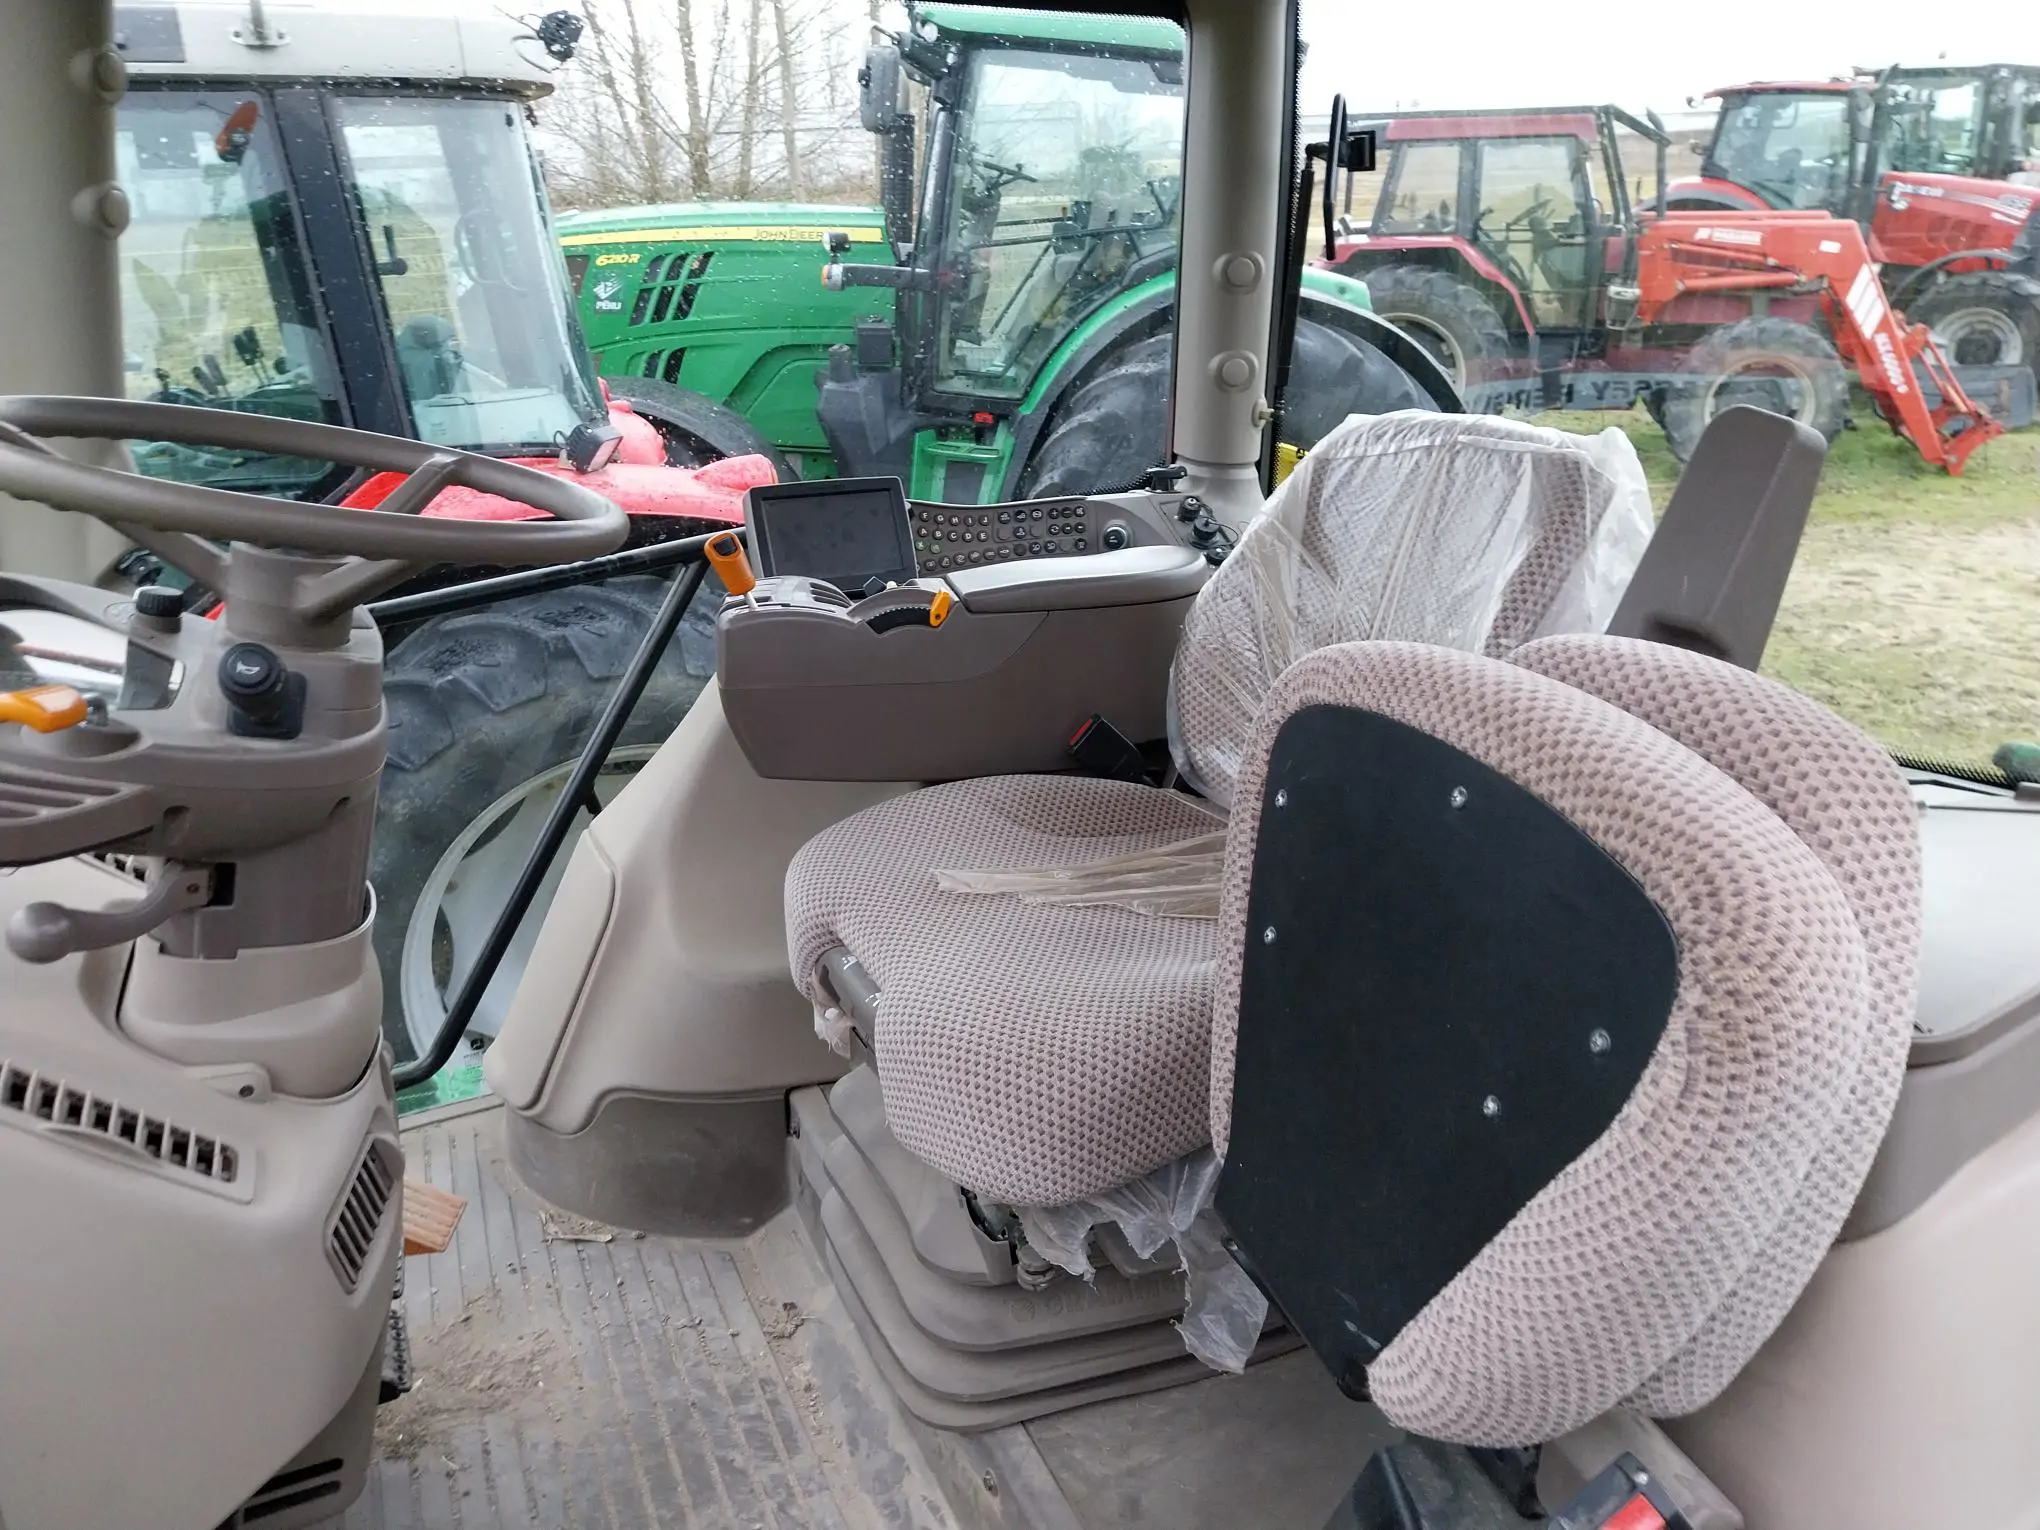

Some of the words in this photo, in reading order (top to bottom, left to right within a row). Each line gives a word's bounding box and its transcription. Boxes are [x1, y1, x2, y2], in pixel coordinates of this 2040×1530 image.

[753, 228, 787, 240] JOHN
[788, 228, 824, 240] DEER
[937, 514, 944, 522] G
[952, 516, 959, 524] H
[965, 532, 972, 540] D
